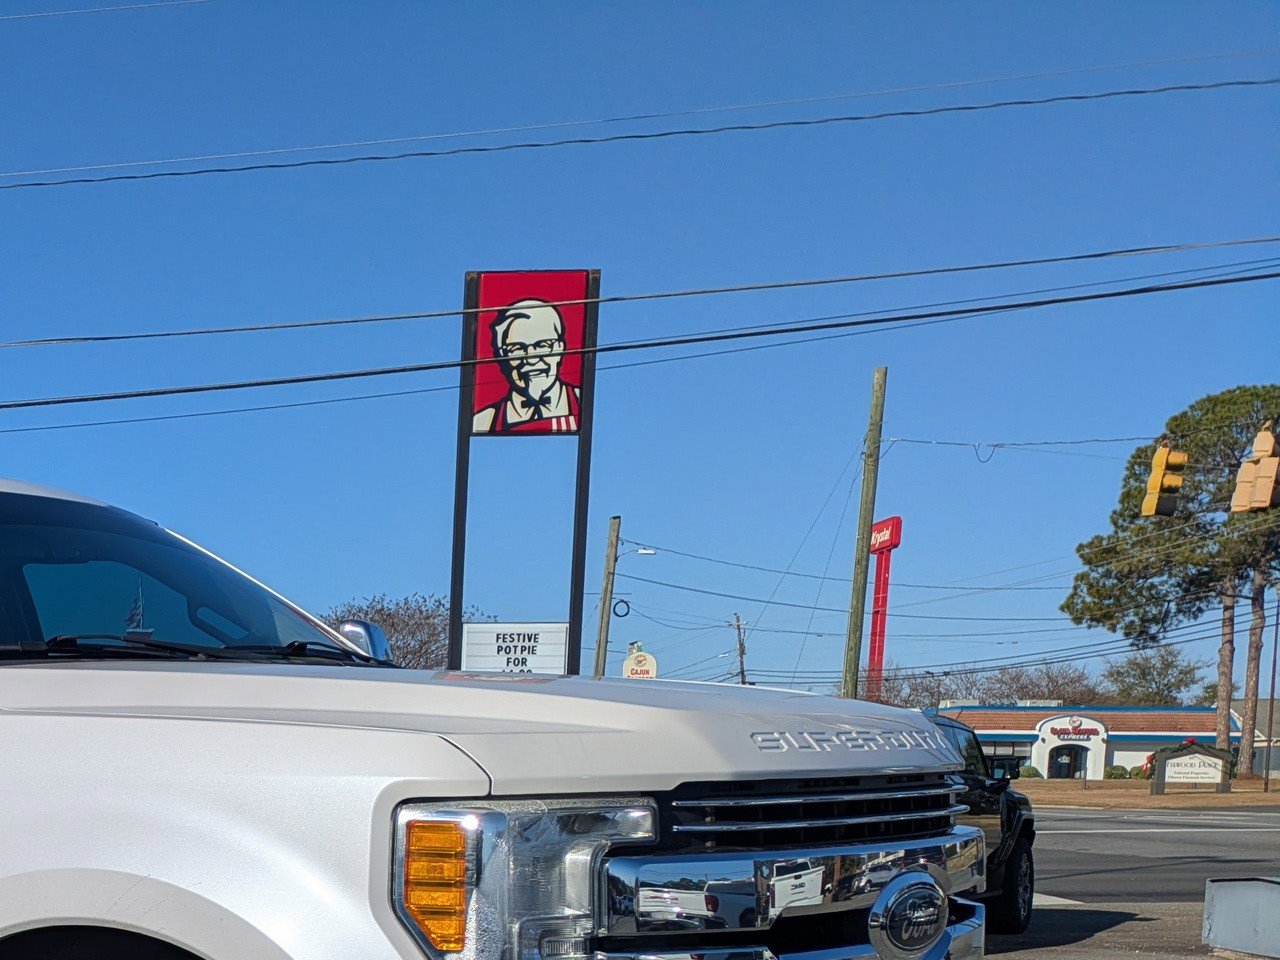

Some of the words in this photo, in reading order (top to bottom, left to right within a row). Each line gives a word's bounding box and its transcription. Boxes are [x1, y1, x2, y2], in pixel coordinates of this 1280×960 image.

[870, 525, 892, 548] Krystal
[496, 632, 540, 643] FESTIVE
[506, 657, 528, 667] FOR
[630, 668, 650, 676] CAJUN
[901, 898, 939, 940] Ford
